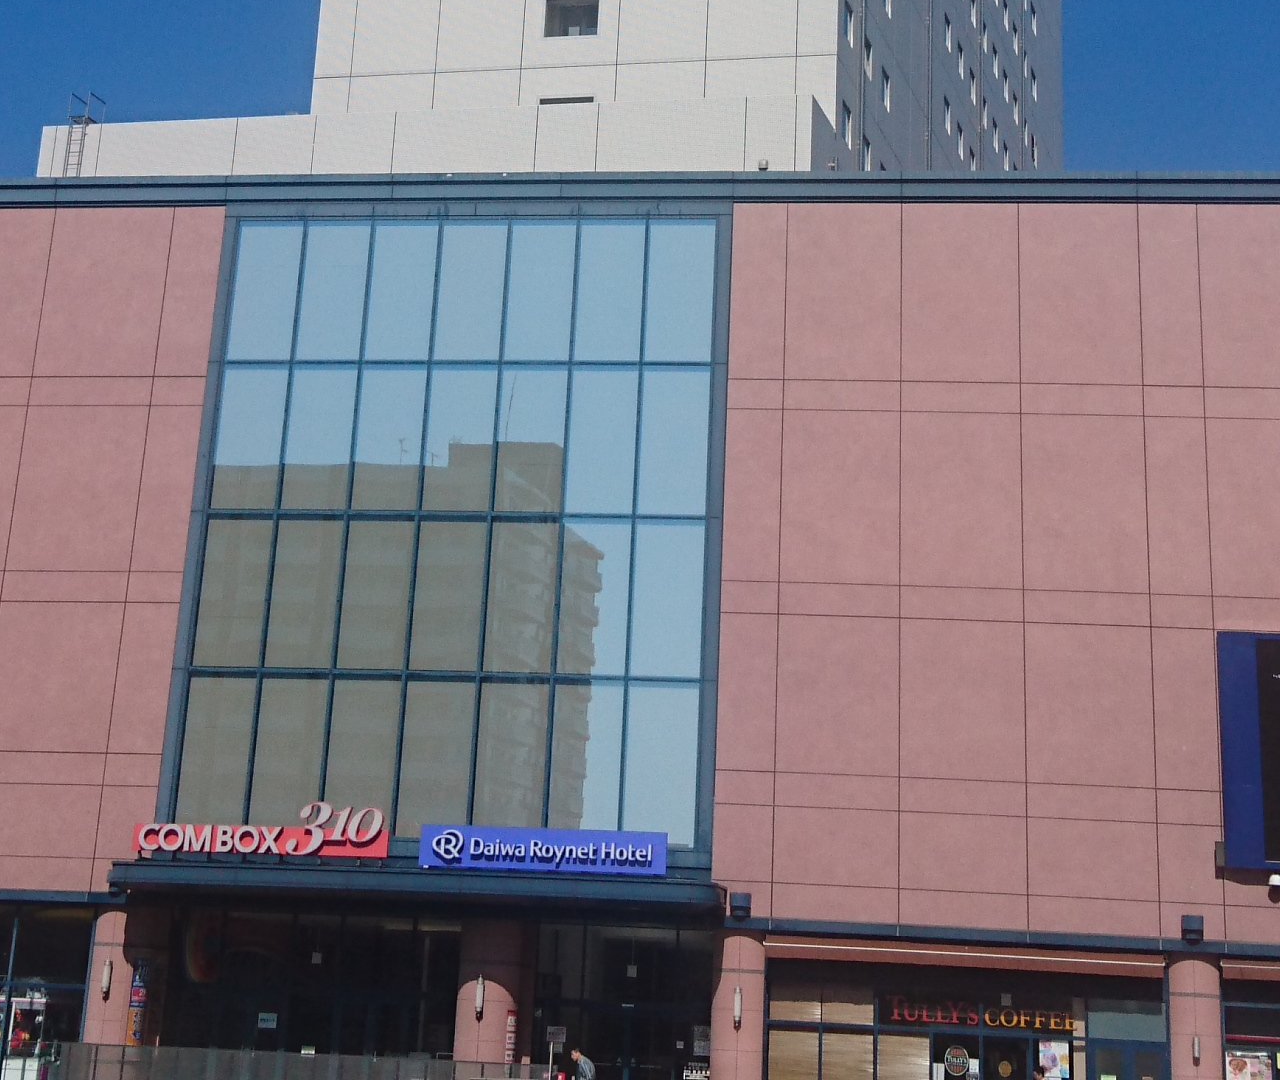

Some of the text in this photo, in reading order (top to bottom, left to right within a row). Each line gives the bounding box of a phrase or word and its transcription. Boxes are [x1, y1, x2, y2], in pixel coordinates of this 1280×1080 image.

[138, 801, 383, 856] COMBOX 310
[470, 837, 653, 864] Daiwa Roynet Hotel
[984, 1006, 1078, 1032] COFFEE
